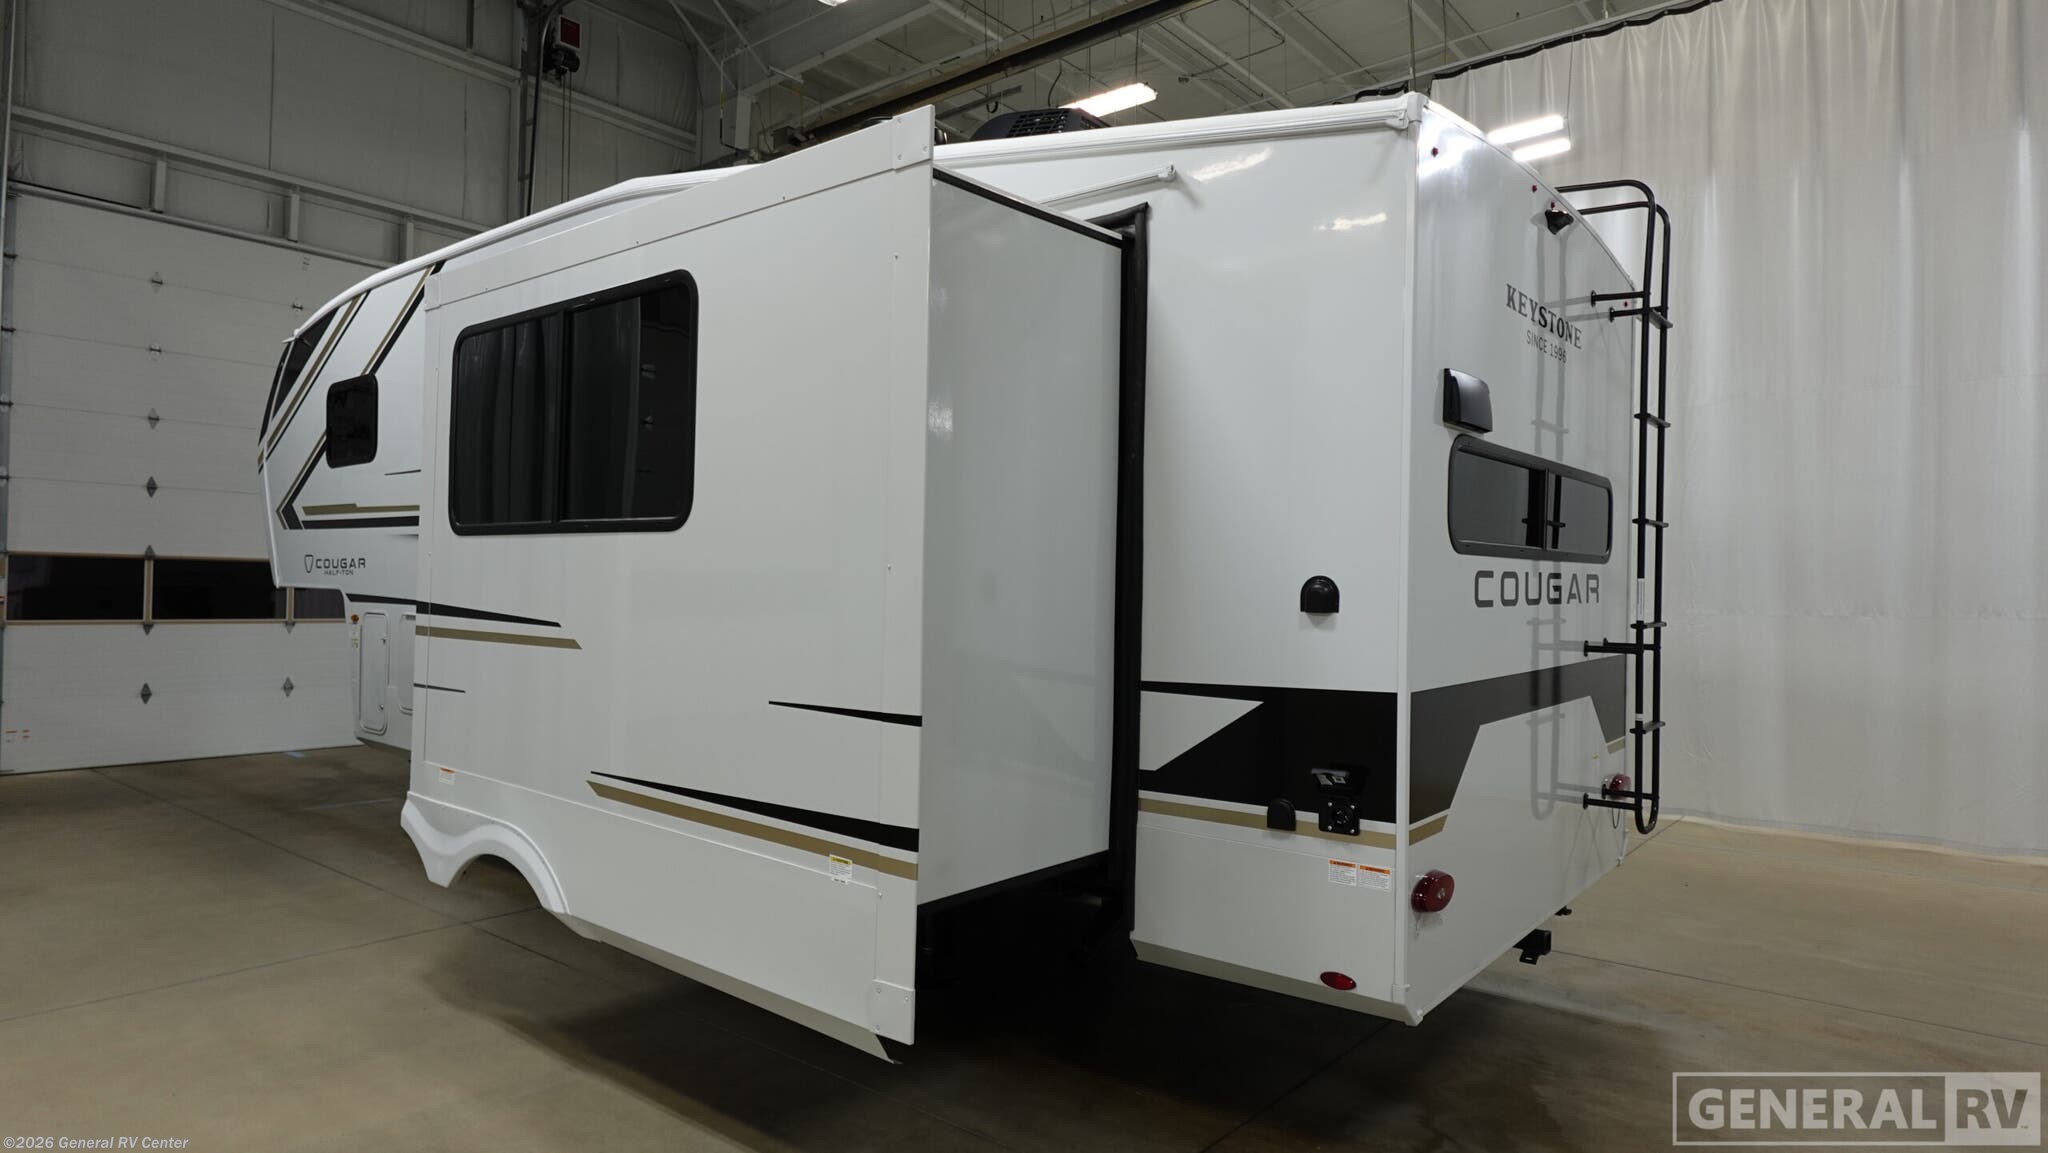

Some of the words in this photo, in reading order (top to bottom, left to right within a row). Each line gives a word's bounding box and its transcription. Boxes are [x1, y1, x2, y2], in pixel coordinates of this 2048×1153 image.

[1506, 283, 1582, 349] KEYSTONE
[1526, 329, 1548, 354] SINCE
[1550, 343, 1566, 364] 1996
[315, 557, 366, 569] COUGAR
[1474, 570, 1600, 608] COUGAR
